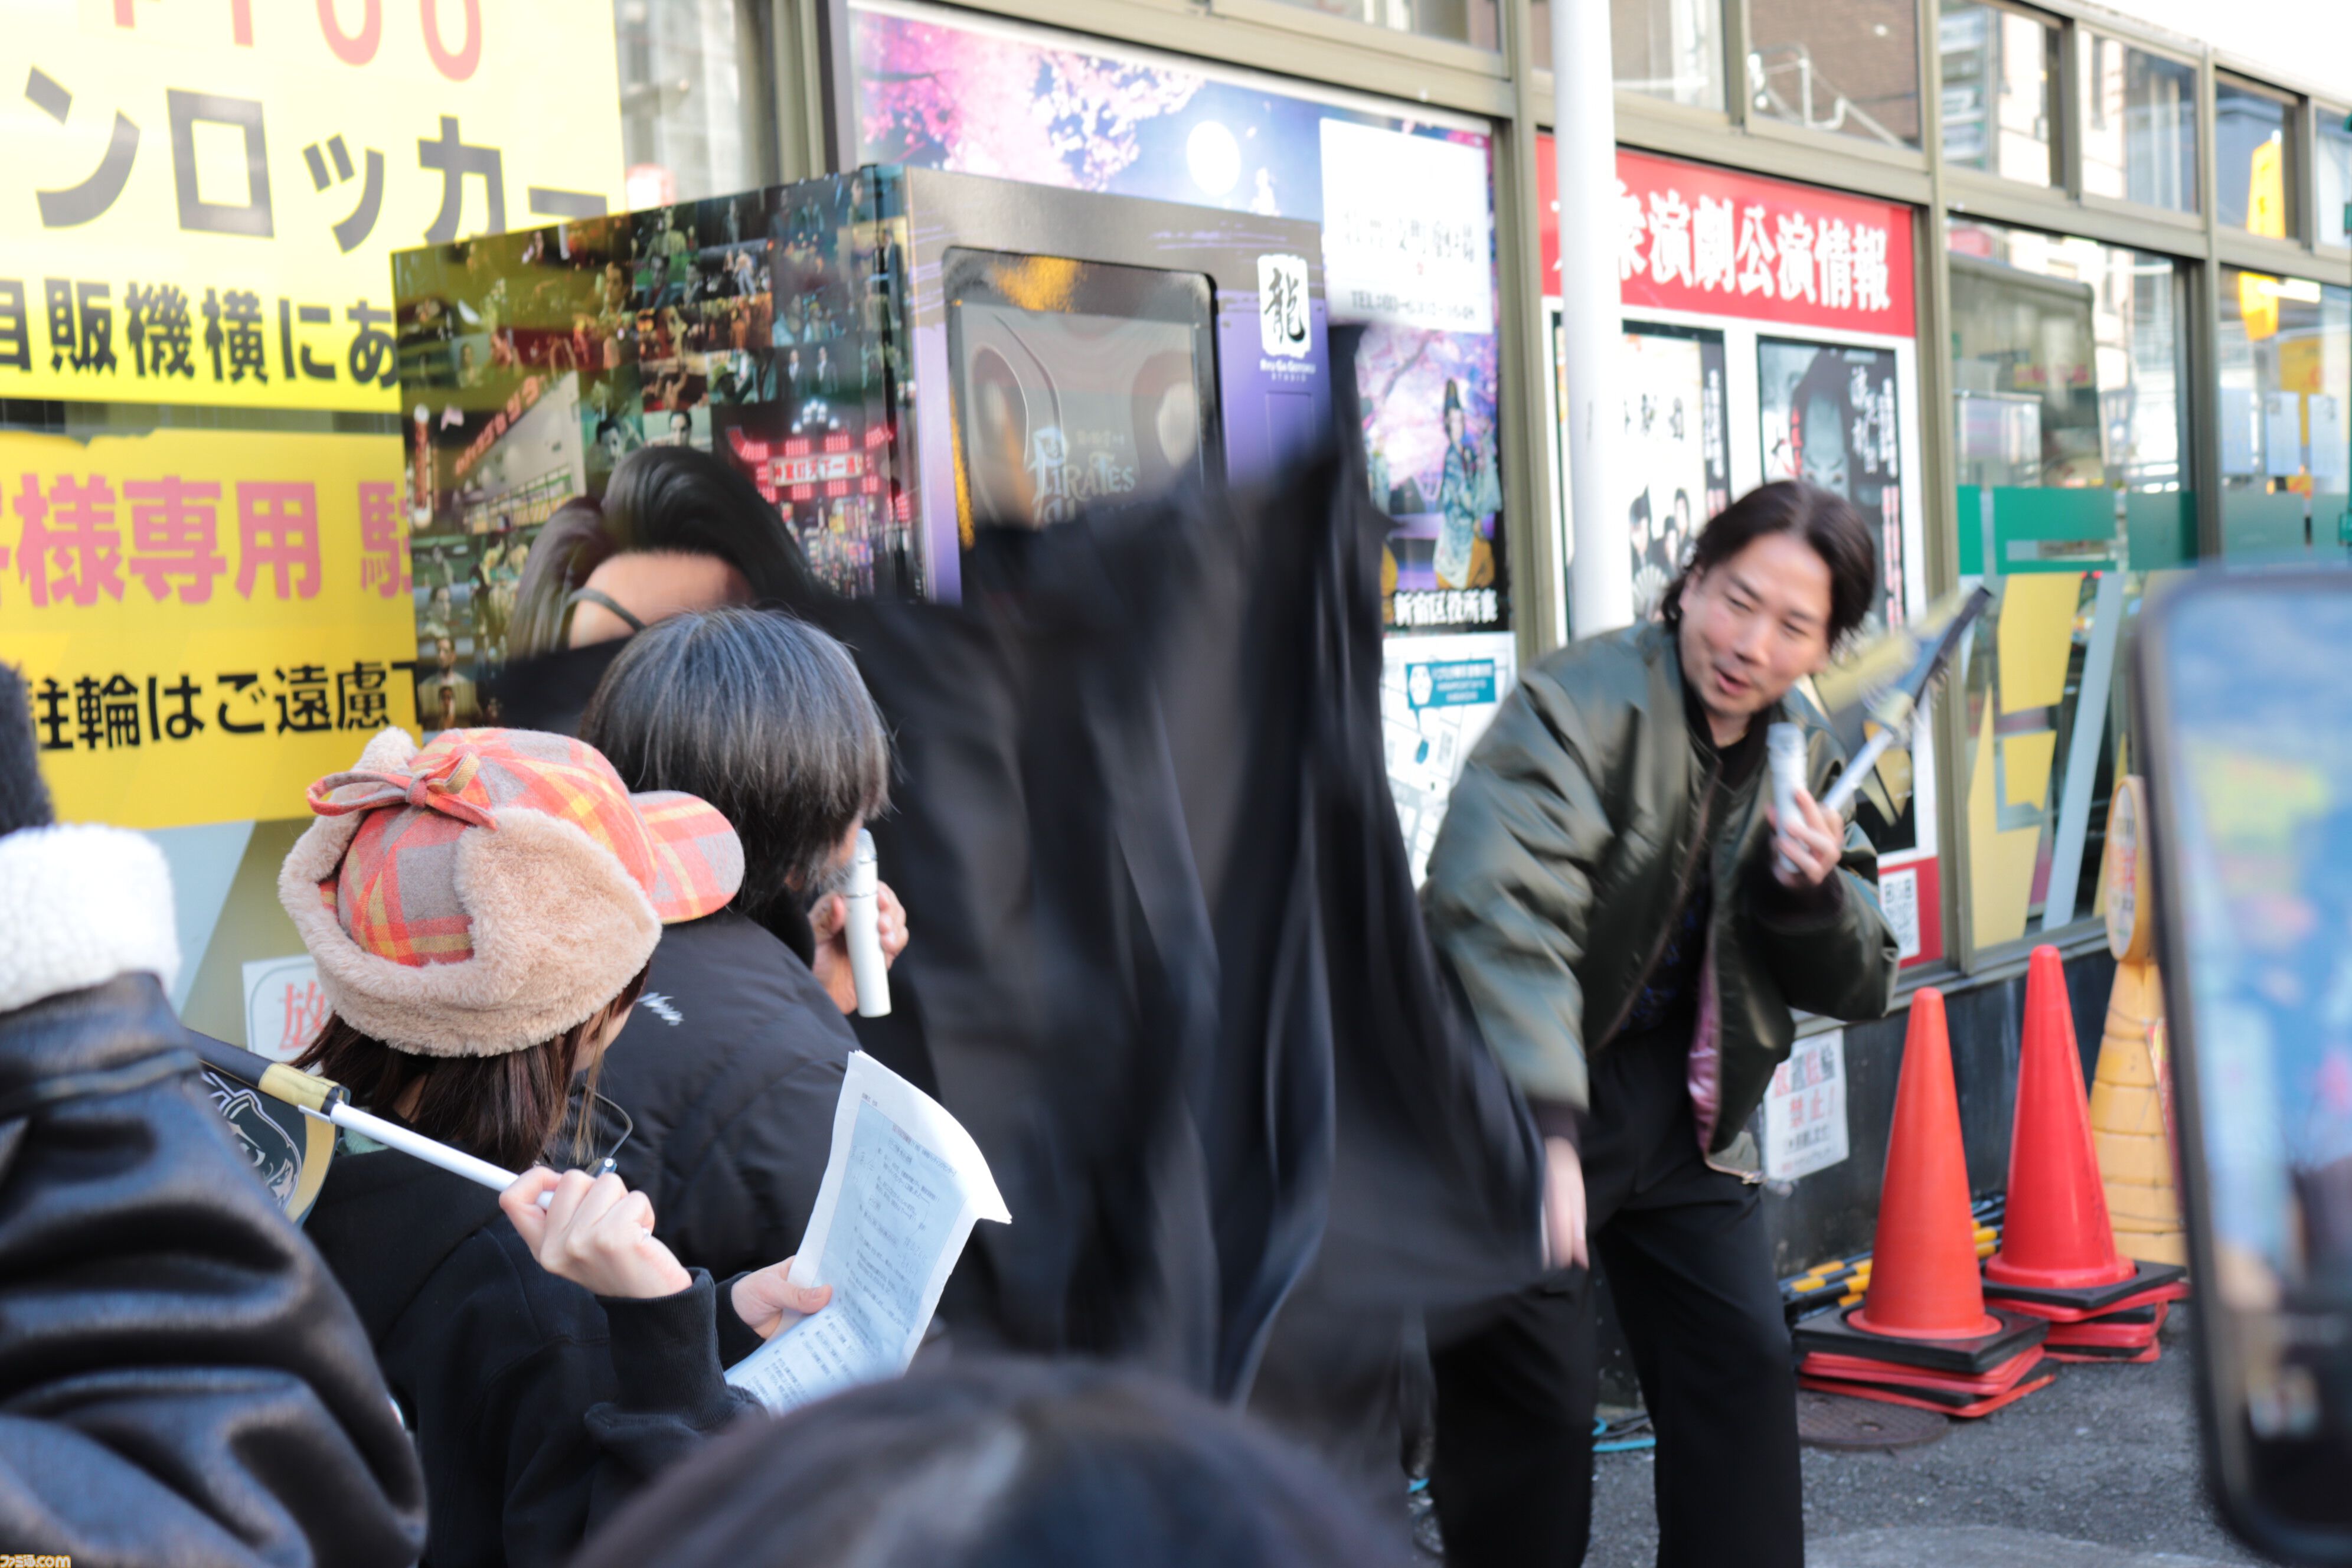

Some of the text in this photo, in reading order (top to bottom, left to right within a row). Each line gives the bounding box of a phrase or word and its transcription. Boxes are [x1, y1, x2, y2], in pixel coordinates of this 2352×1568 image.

[25, 64, 608, 254] ンロッカー
[1551, 179, 1891, 312] 衆演劇公演情報
[0, 473, 322, 607] 様専用
